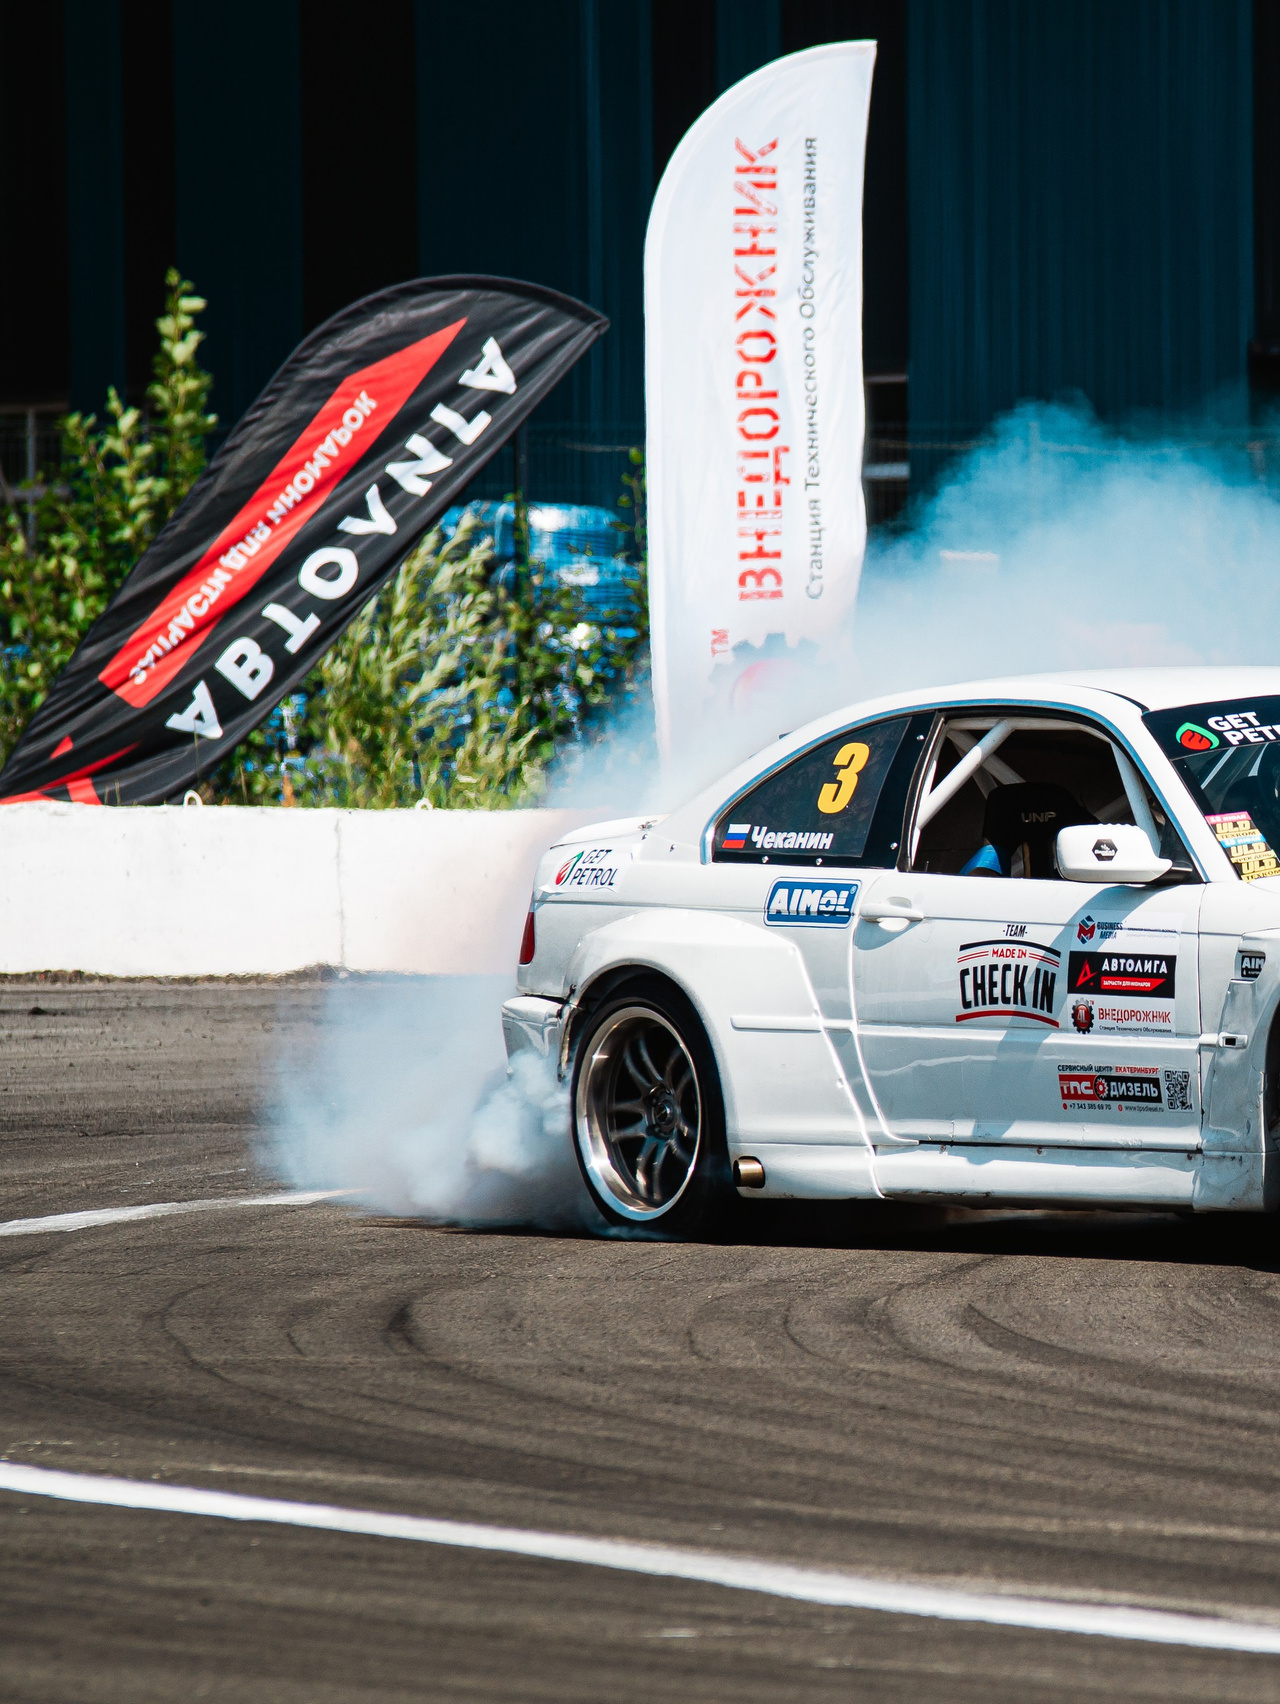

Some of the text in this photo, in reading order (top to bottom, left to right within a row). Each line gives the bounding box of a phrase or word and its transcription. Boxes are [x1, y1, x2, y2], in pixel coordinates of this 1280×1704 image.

[734, 137, 790, 602] ВНЕДОРОЖНИК
[798, 137, 824, 600] Станция Технического Обслуживания
[1207, 711, 1260, 731] GET
[817, 742, 870, 814] 3
[1216, 820, 1251, 834] ULD
[751, 826, 834, 850] Чеканин
[582, 849, 613, 864] GET
[1230, 842, 1266, 857] ULD
[1242, 858, 1277, 874] ULD
[569, 868, 618, 886] PETROL
[768, 888, 850, 917] AIMOL
[1097, 921, 1123, 931] BUSINESS
[1099, 930, 1118, 940] MEDIA
[992, 947, 1027, 958] MADE IN
[1102, 958, 1168, 974] АВТОЛИГА
[960, 964, 1057, 1014] CHECK IN
[1098, 1008, 1172, 1024] ВНЕДОРОЖНИК
[1057, 1063, 1160, 1075] СЕРВИСНЫЙ ЦЕНТР ЕКАТЕРИНБУРГ
[1109, 1081, 1159, 1098] ДИЗЕЛЬ
